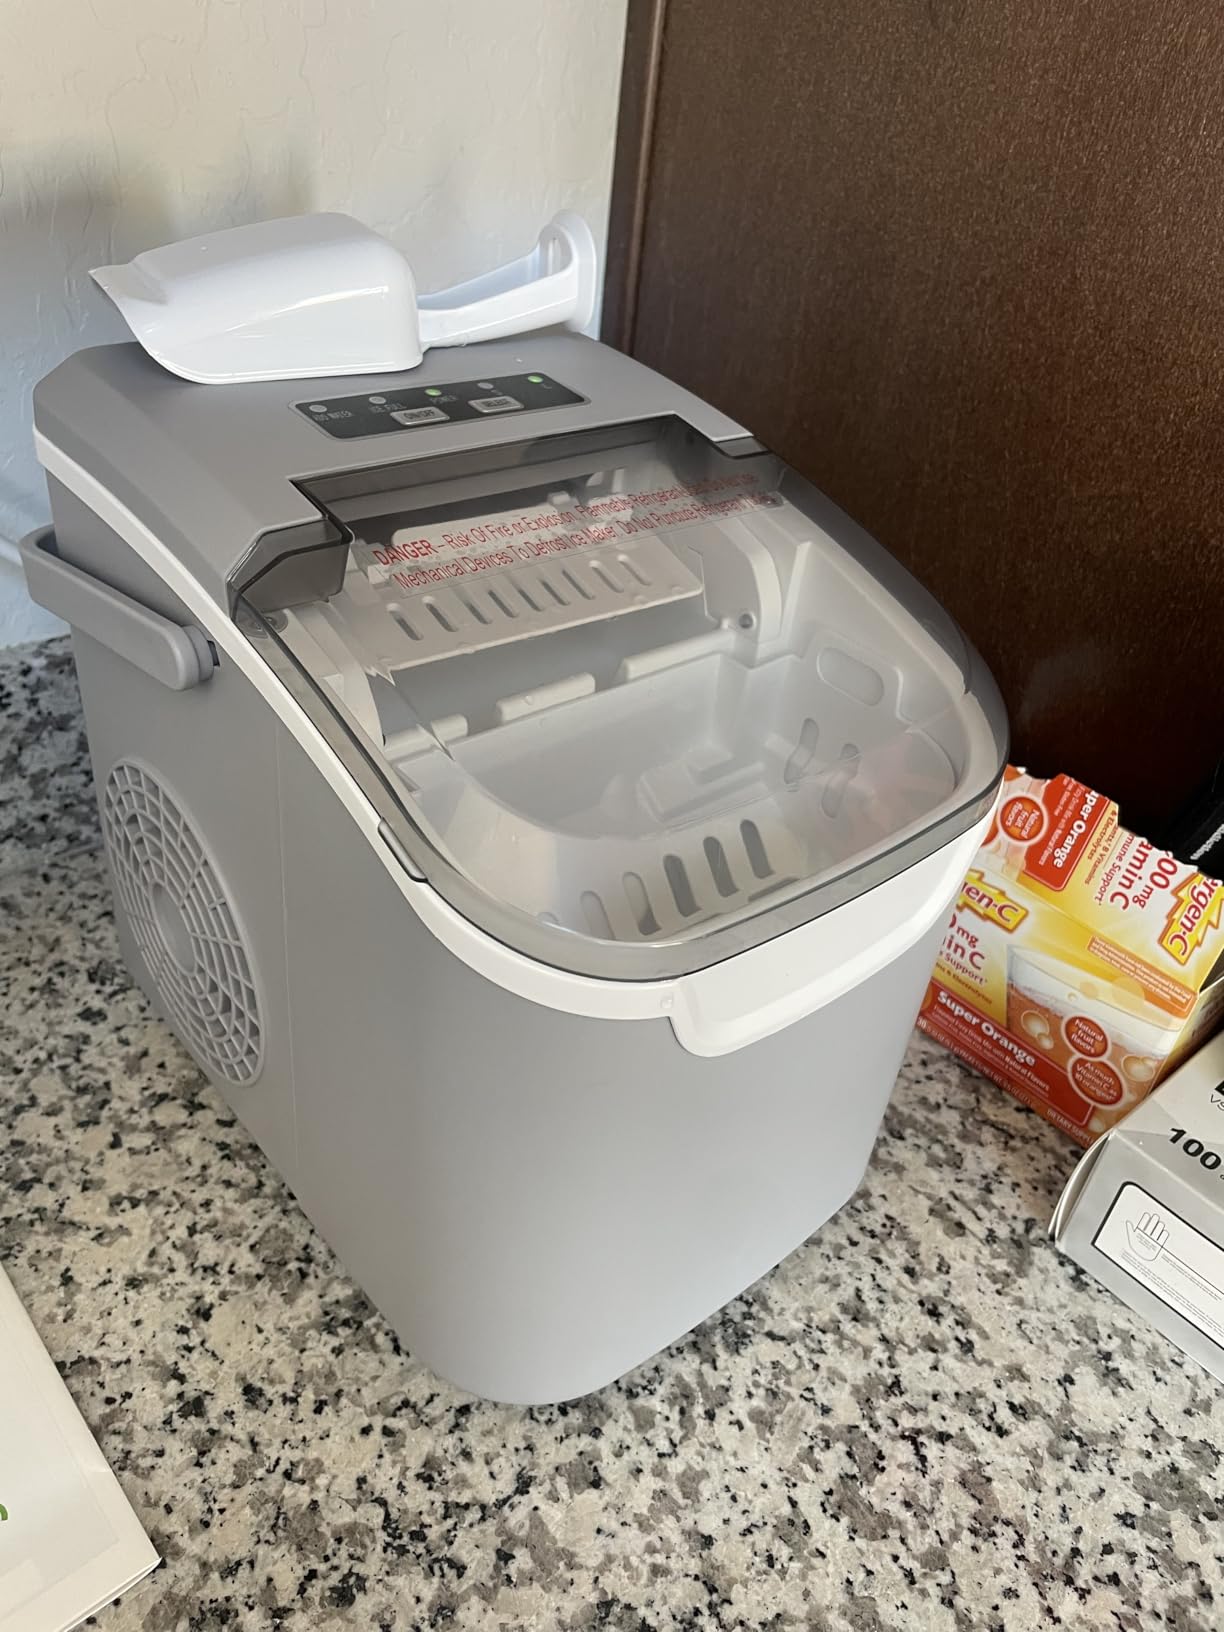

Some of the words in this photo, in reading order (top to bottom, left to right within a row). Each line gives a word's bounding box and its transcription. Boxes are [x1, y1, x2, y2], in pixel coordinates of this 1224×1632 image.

[372, 539, 439, 566] DANGER
[442, 530, 476, 550] Risk
[470, 525, 491, 543] Of
[485, 522, 514, 540] Fire
[511, 521, 526, 534] or
[574, 498, 634, 518] Flammable
[393, 559, 468, 589] Mechanical
[461, 550, 514, 572] Devices
[506, 544, 530, 559] To
[523, 536, 570, 557] Defrost
[563, 533, 588, 549] Ice
[615, 520, 639, 535] Do
[631, 515, 658, 531] Not
[649, 508, 699, 527] Puncture
[1004, 801, 1023, 827] flavors
[1013, 809, 1029, 828] fruit
[1019, 808, 1040, 838] Natural
[1053, 819, 1086, 868] Orange
[1087, 816, 1114, 861] Electrolytes
[1084, 852, 1106, 885] Vitamins
[1149, 850, 1178, 889] 00
[1109, 891, 1130, 911] C
[1132, 884, 1154, 909] mg
[956, 925, 979, 948] mg
[942, 934, 966, 959] in
[968, 951, 986, 970] C
[937, 990, 980, 1026] Super
[981, 1021, 1036, 1067] Orange
[1075, 1019, 1104, 1042] Natural
[1078, 1030, 1095, 1045] fruit
[1071, 1034, 1096, 1054] flavors
[1004, 1055, 1028, 1076] Natural
[1027, 1071, 1050, 1092] Flavors
[1076, 1063, 1103, 1087] Vitamin
[1085, 1062, 1095, 1071] As
[1169, 1127, 1222, 1170] 100
